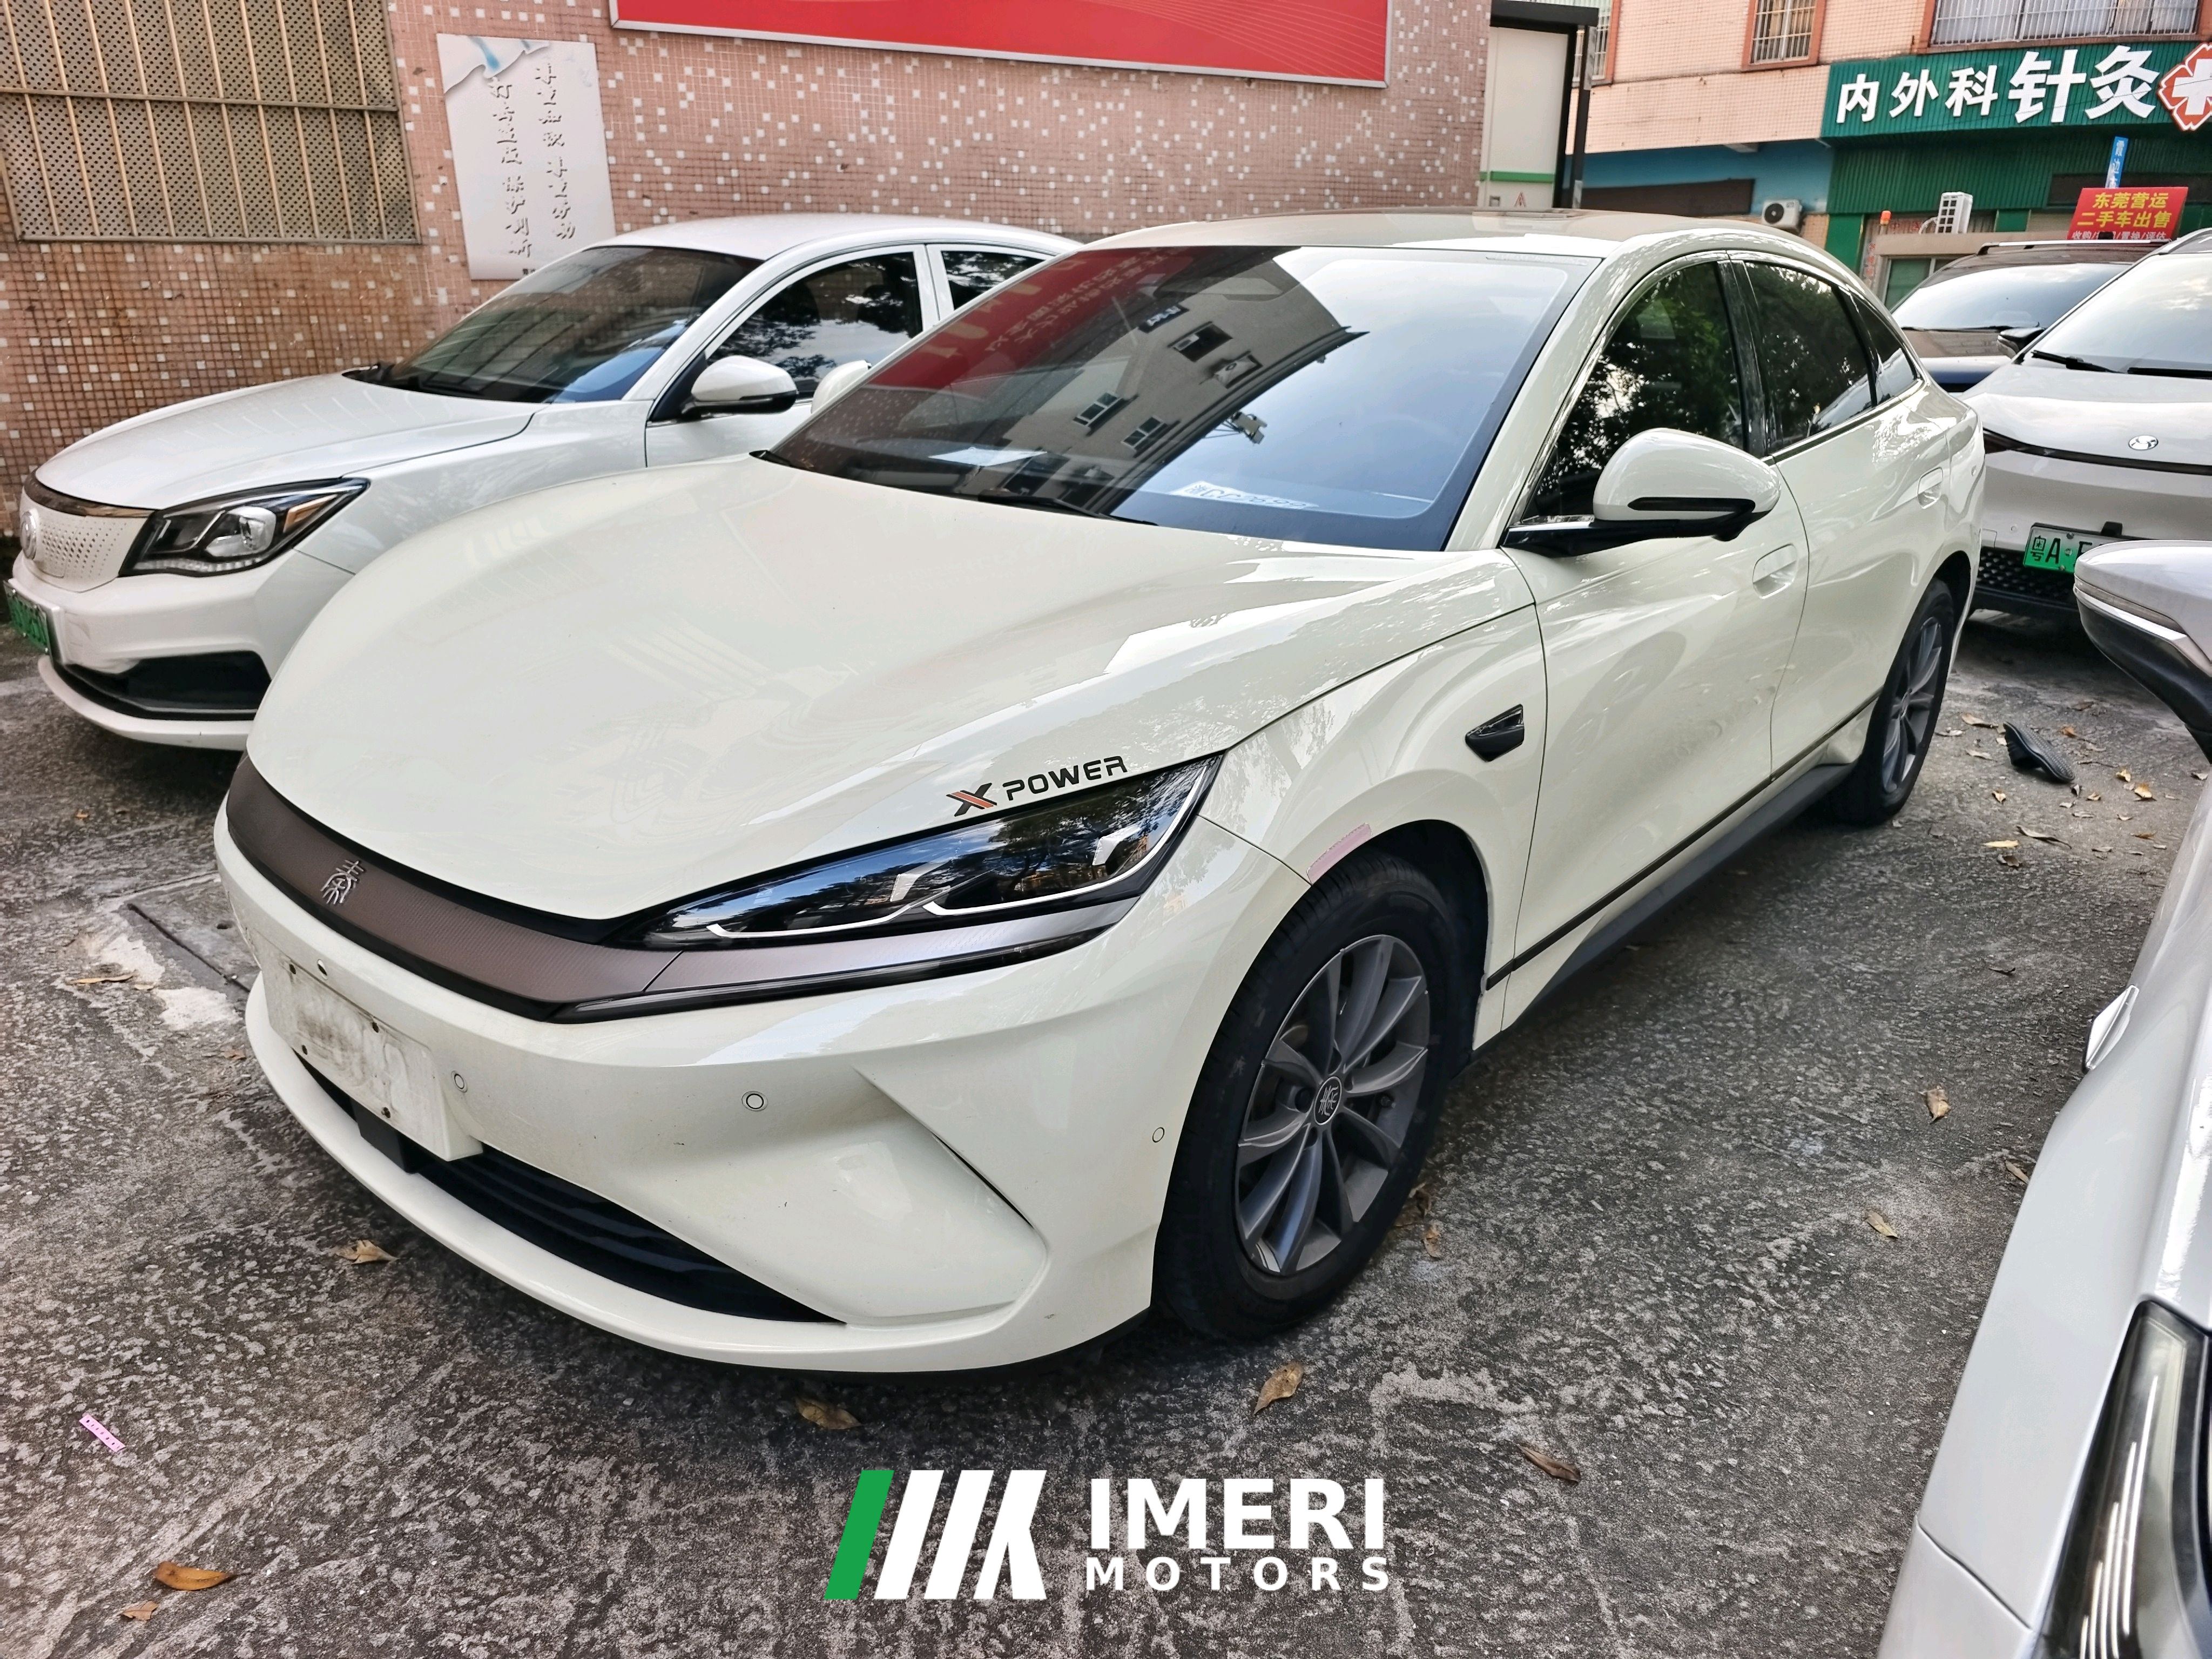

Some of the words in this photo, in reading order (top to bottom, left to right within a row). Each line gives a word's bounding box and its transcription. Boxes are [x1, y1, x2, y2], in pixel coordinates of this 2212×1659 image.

[2093, 192, 2168, 208] 东莞营运
[2077, 211, 2172, 228] 二手车出售
[1003, 756, 1128, 801] POWER
